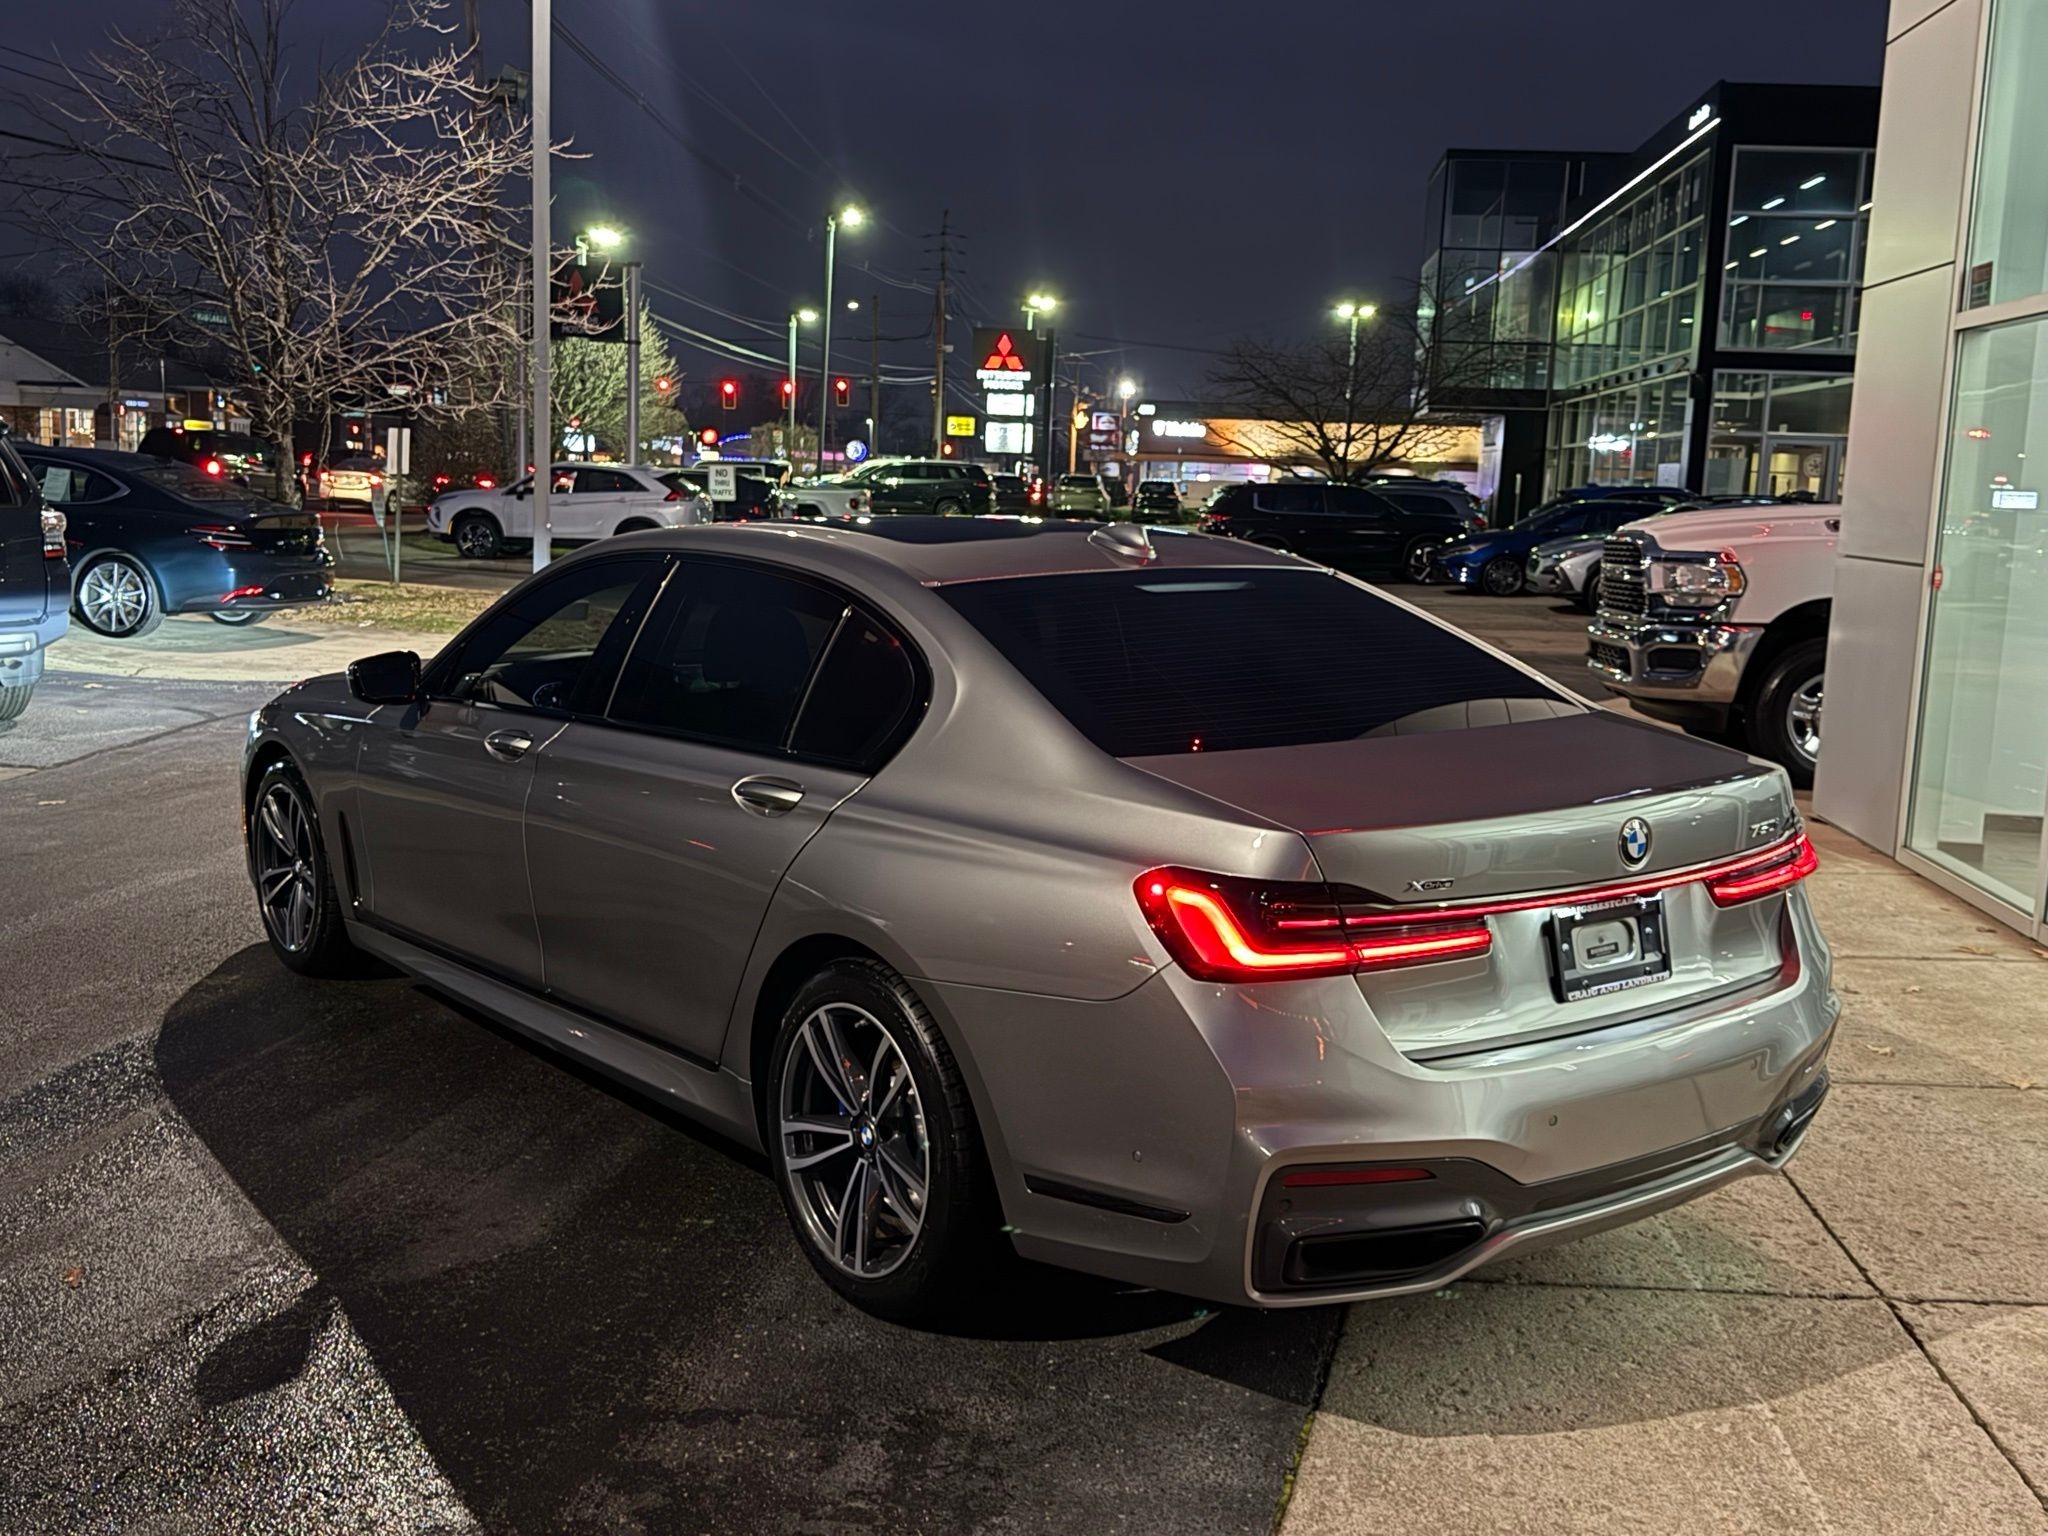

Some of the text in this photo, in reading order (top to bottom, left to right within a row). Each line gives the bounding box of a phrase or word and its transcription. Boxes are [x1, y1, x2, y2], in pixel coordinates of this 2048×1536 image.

[715, 469, 728, 478] NO
[1568, 987, 1598, 1001] CRAIG
[1600, 983, 1620, 994] AND
